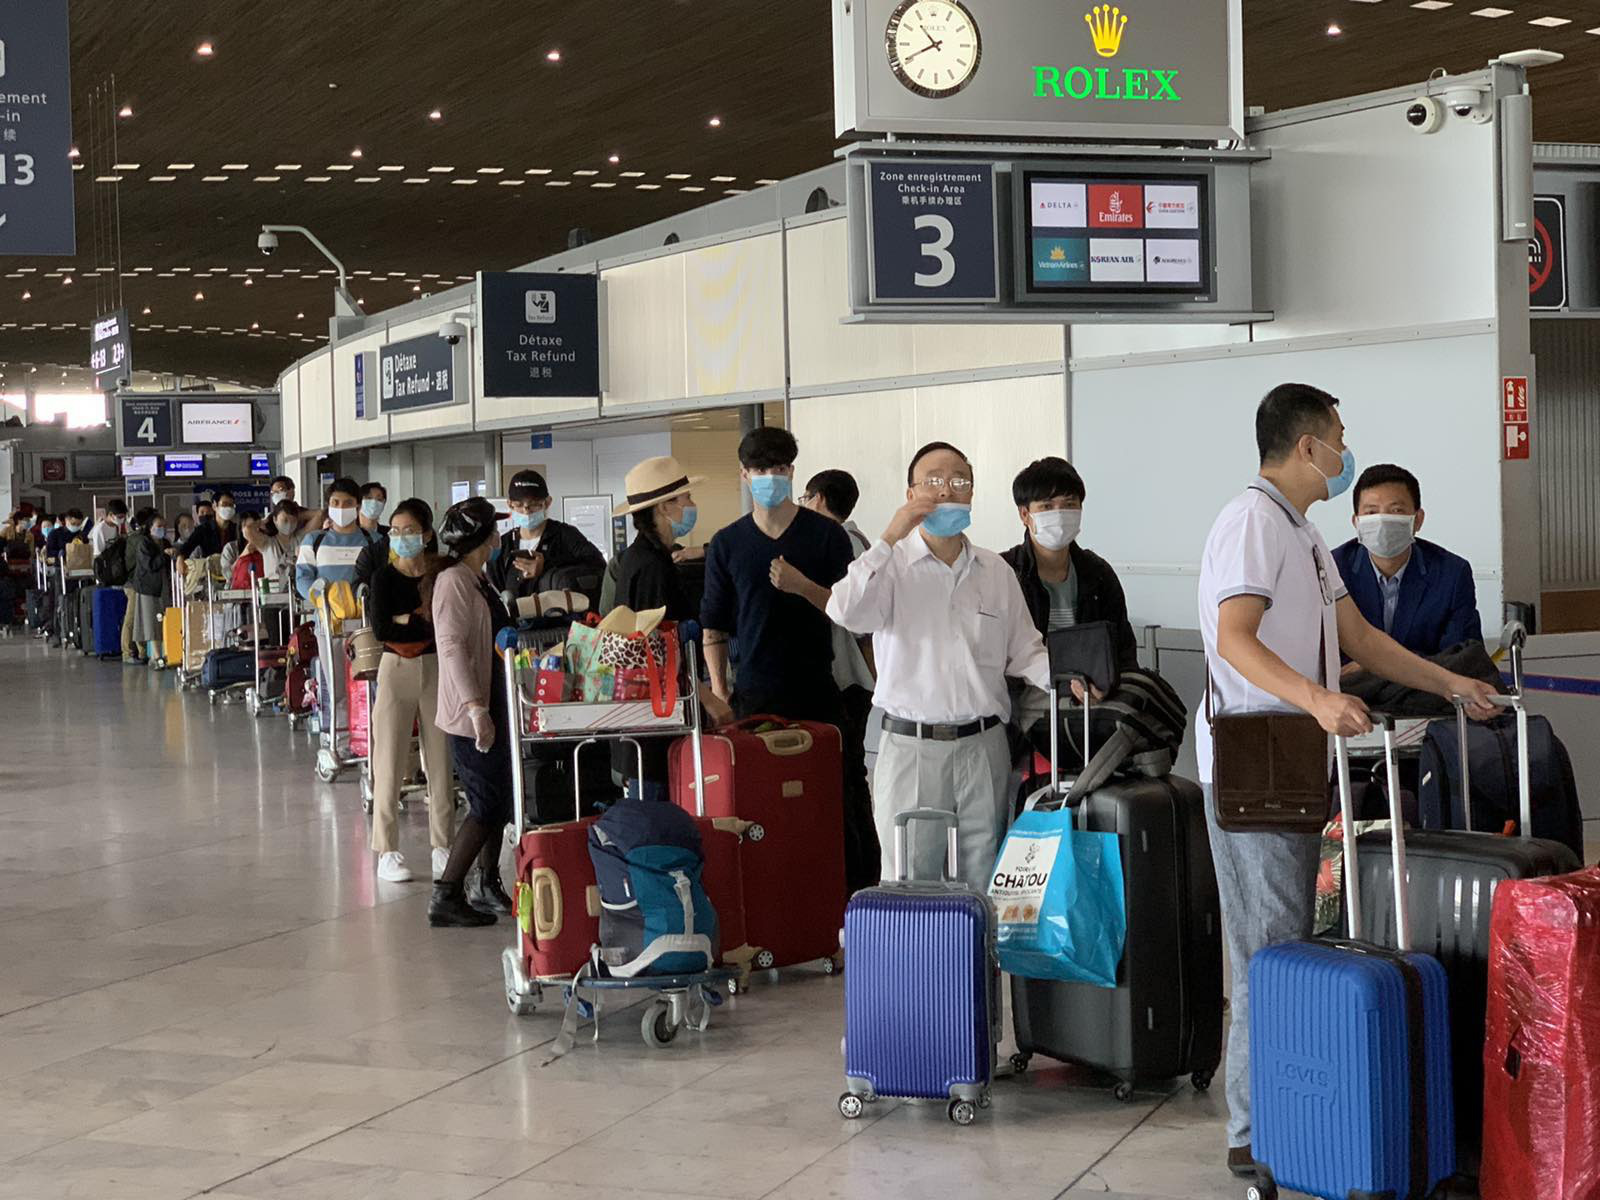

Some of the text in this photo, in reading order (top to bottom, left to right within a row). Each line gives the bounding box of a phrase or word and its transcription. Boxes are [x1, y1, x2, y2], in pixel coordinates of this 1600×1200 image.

[1032, 66, 1181, 100] ROLEX
[880, 172, 981, 183] Zone enregistrement
[898, 184, 965, 193] Check-in Area
[1099, 212, 1133, 222] Emirates
[914, 214, 956, 287] 3
[519, 335, 563, 346] Détaxe
[395, 352, 416, 373] Détaxe
[506, 350, 576, 362] Tax Refund
[395, 371, 430, 397] Tax Refund
[137, 417, 157, 443] 4
